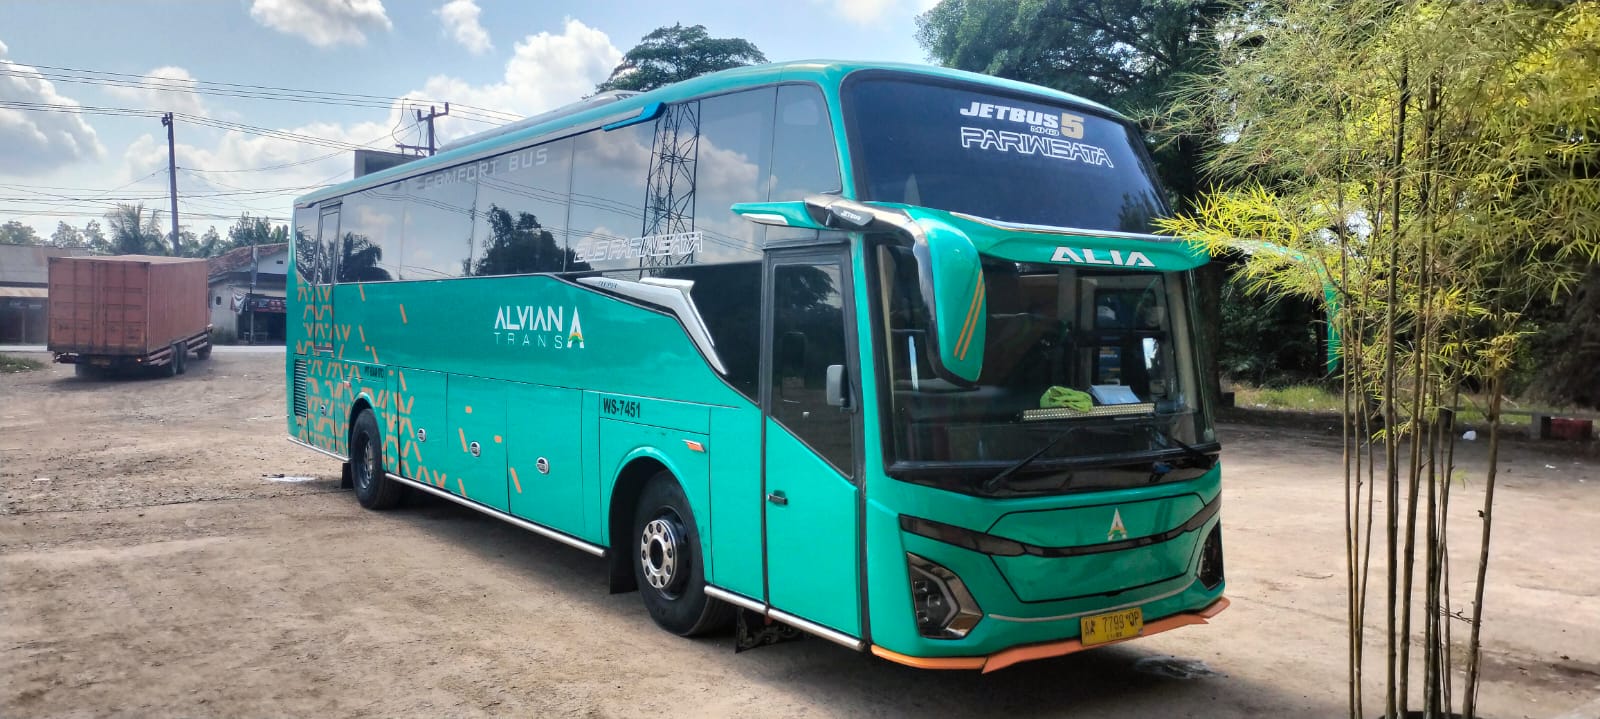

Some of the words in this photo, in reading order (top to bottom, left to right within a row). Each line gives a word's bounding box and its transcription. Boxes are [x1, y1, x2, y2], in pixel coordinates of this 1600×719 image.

[960, 101, 1058, 129] JETBUS
[1061, 112, 1084, 139] 5
[424, 160, 498, 190] COMFORT
[509, 149, 548, 171] BUS
[1051, 246, 1155, 267] ALIA
[494, 305, 563, 332] ALVIAN
[493, 332, 563, 349] TRANS
[603, 398, 640, 418] WS-7451
[1102, 614, 1125, 633] 7799
